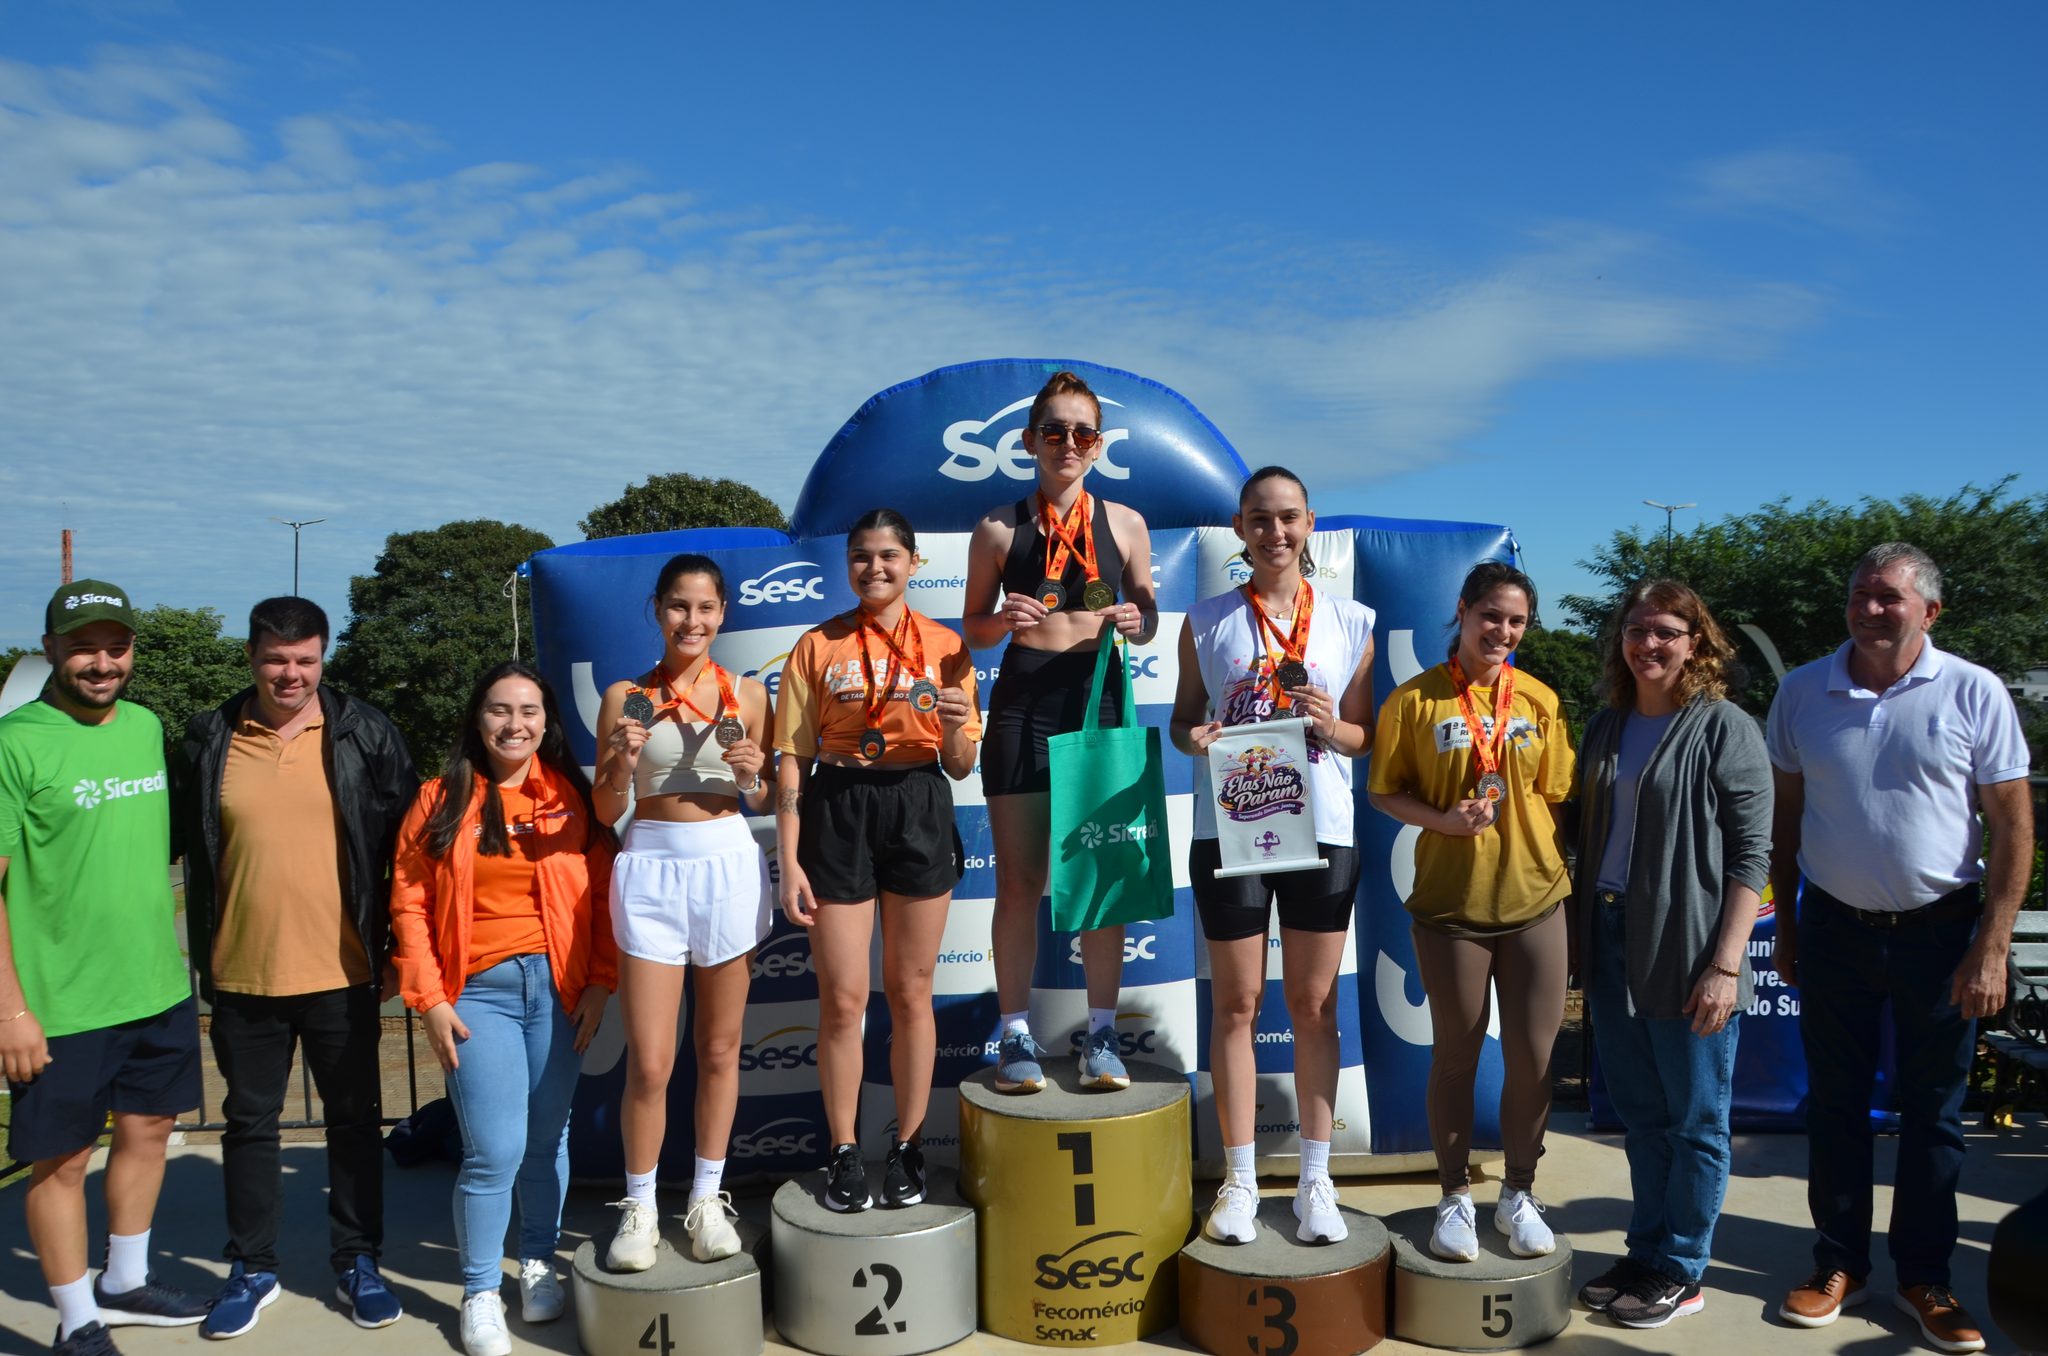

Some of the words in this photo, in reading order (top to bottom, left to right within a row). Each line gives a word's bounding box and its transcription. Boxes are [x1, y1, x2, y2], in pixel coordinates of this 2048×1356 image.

[938, 419, 1130, 482] Sec
[738, 576, 825, 606] Sesc
[908, 575, 967, 590] ecomér
[80, 593, 123, 608] Sicredi
[104, 769, 167, 800] Sicredi
[1226, 774, 1260, 798] Elas
[1260, 772, 1295, 793] Não
[1233, 784, 1300, 812] Param
[1108, 819, 1158, 844] Sicredi
[1068, 935, 1156, 965] Ssc
[1776, 994, 1801, 1017] Su
[1068, 1029, 1156, 1057] Ssc
[732, 1131, 817, 1158] Sesc
[1034, 1250, 1145, 1290] Sesc
[852, 1262, 907, 1336] 2
[1033, 1297, 1145, 1320] Fecomércio
[1246, 1285, 1299, 1356] 3
[1481, 1293, 1513, 1339] 5
[638, 1312, 676, 1356] 4
[1035, 1324, 1097, 1341] Senac
